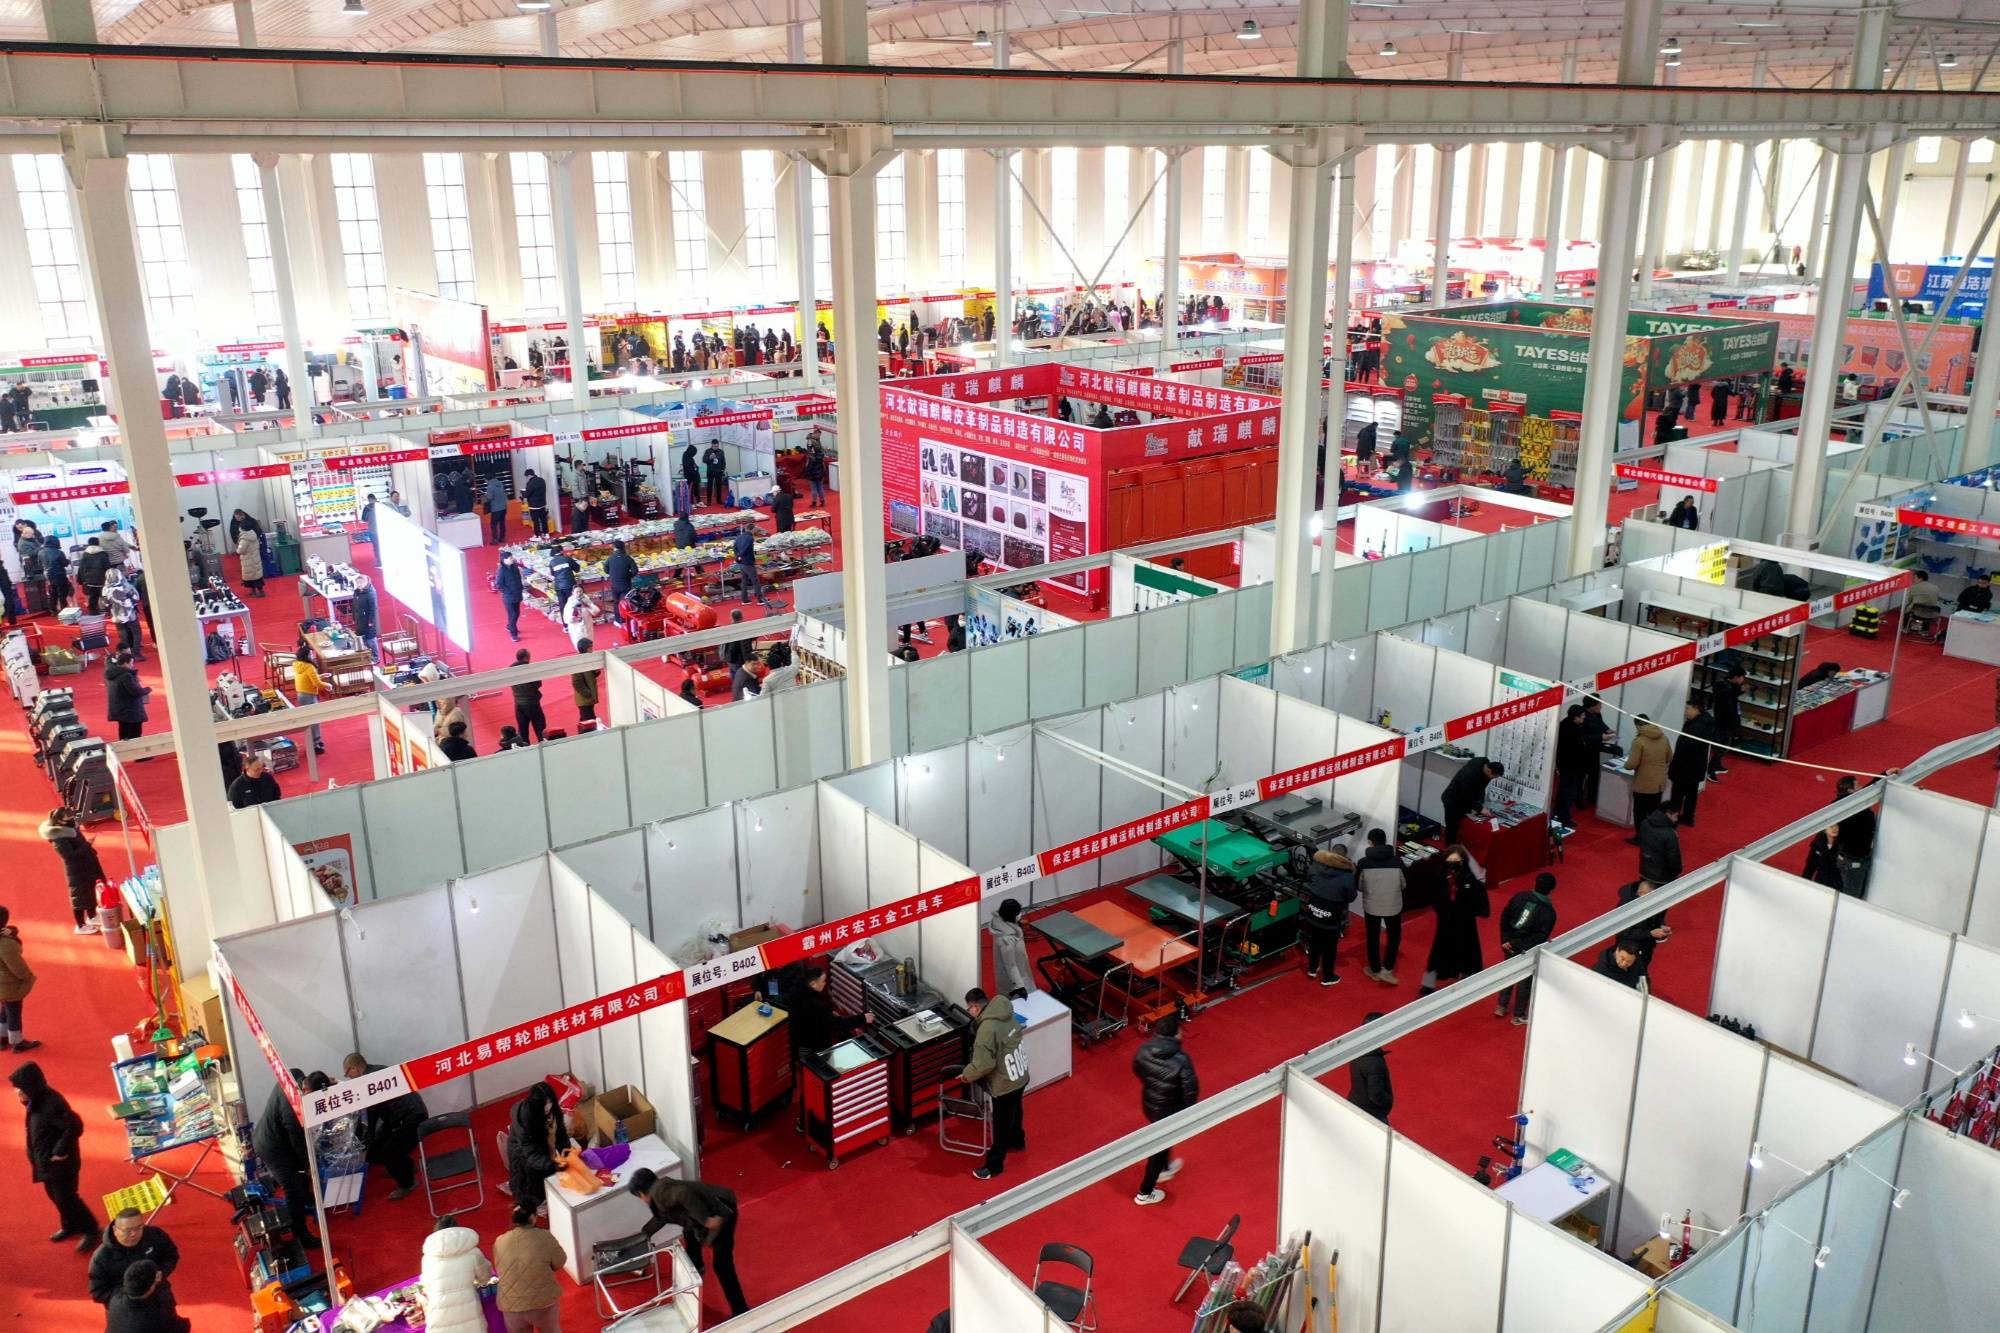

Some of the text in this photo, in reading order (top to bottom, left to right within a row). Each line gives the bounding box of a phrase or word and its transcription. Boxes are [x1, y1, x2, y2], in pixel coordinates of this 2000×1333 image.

[941, 374, 1024, 398] 献瑞麒麟
[1079, 372, 1280, 412] 河北献福麒麟皮革制品制造有限公
[885, 393, 1085, 453] 河北献福麒麟皮革制品制造有限公司
[1187, 416, 1277, 448] 献瑞麒麟
[1429, 729, 1443, 742] B405
[1269, 745, 1395, 793] 保定捷丰起重搬运机械制造有限公司
[1239, 788, 1256, 801] B404
[1052, 805, 1198, 867] 保定捷丰起重搬运机械制造有限公司
[1017, 863, 1036, 878] B403
[801, 894, 944, 951] 霸州庆宏五金工具车
[732, 955, 757, 972] B402
[435, 985, 659, 1075] 河北易帮轮胎耗材有限公司
[367, 1075, 399, 1097] B401
